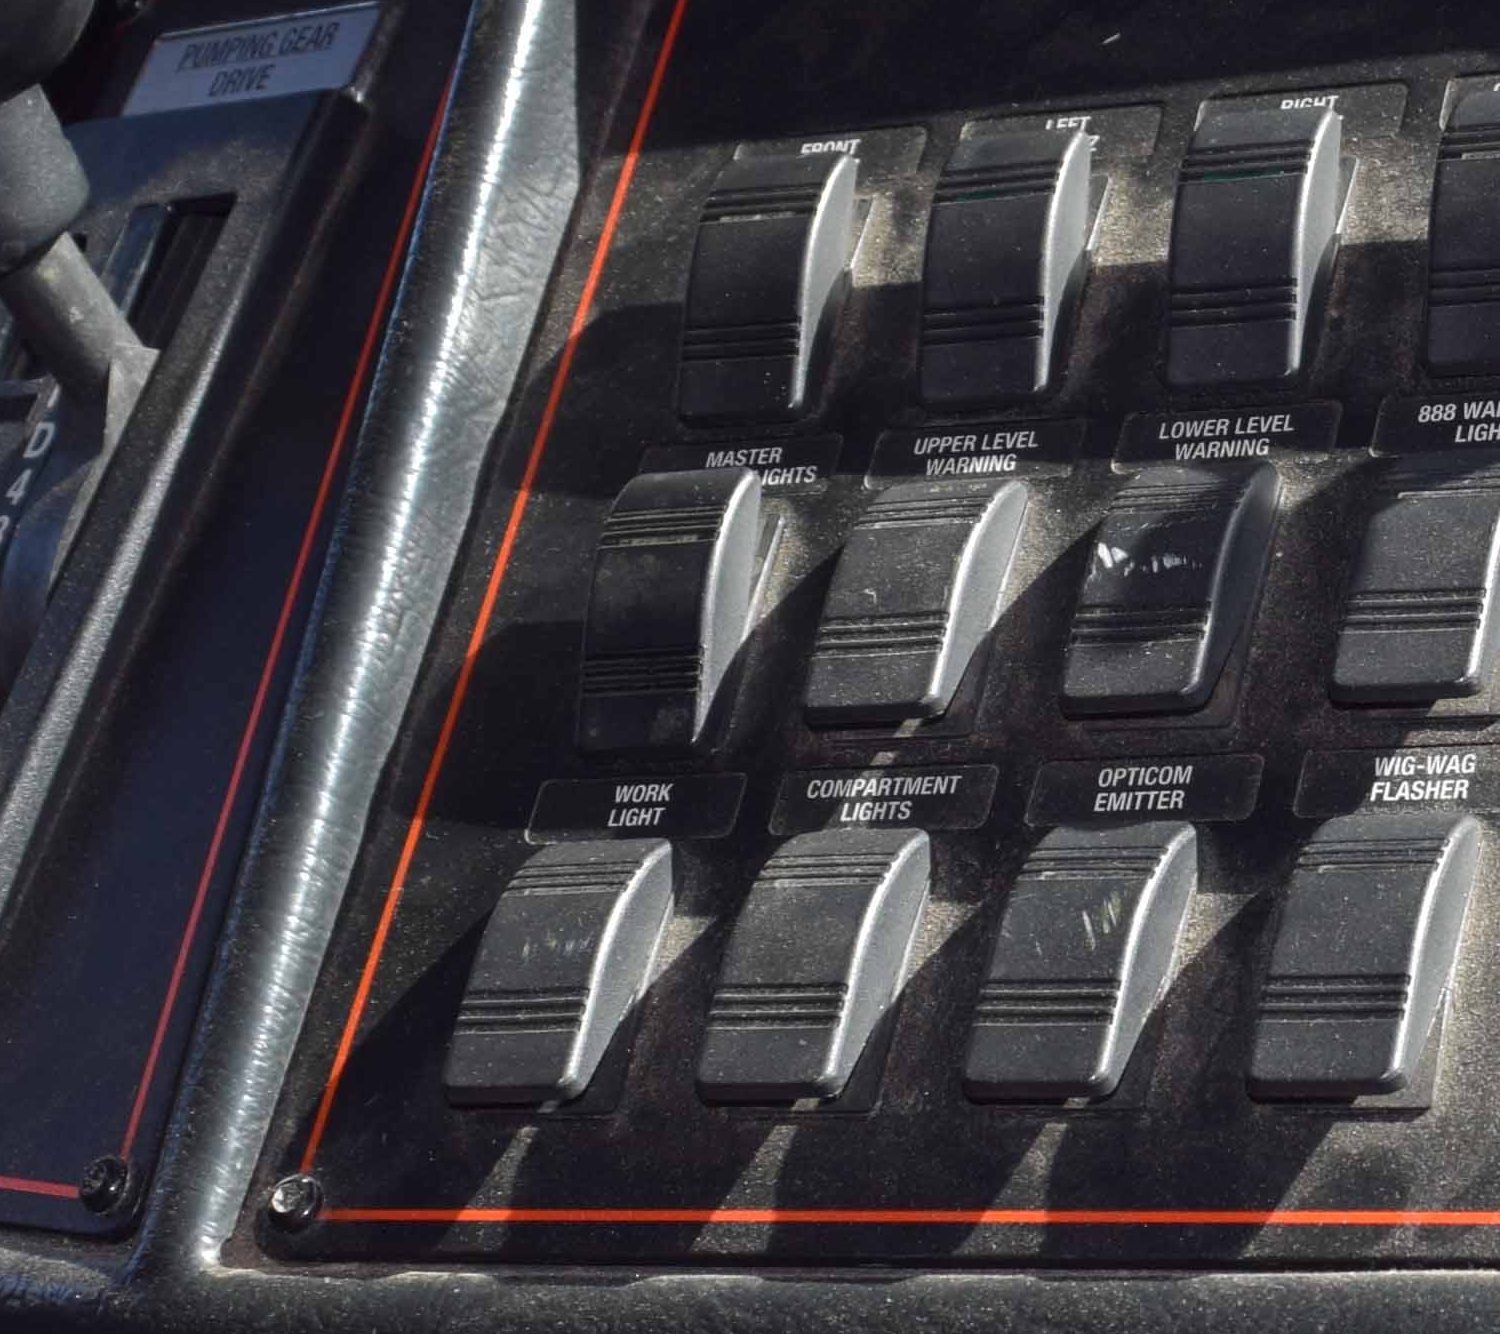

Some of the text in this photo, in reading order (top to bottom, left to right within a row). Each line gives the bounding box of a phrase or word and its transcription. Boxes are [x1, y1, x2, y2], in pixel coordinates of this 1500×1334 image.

[176, 22, 341, 74] PUMPING GEAR
[208, 63, 276, 97] DRIVE
[1417, 403, 1457, 423] 888
[1159, 414, 1295, 440] LOWER LEVEL
[23, 422, 55, 459] D
[914, 431, 1039, 455] UPPER LEVEL
[1174, 439, 1270, 460] WARNING
[705, 447, 783, 468] MASTER
[926, 455, 1017, 476] WARNING
[760, 466, 818, 485] IGHTS
[5, 468, 33, 506] 4
[1097, 765, 1194, 787] OPTICOM
[1373, 754, 1477, 777] WIG-WAG
[614, 783, 674, 803] WORK
[806, 775, 962, 799] COMPARTMENT
[1369, 780, 1470, 802] FLASHER
[840, 801, 912, 822] LIGHTS
[1093, 790, 1186, 812] EMITTER
[607, 806, 666, 827] LIGHT
